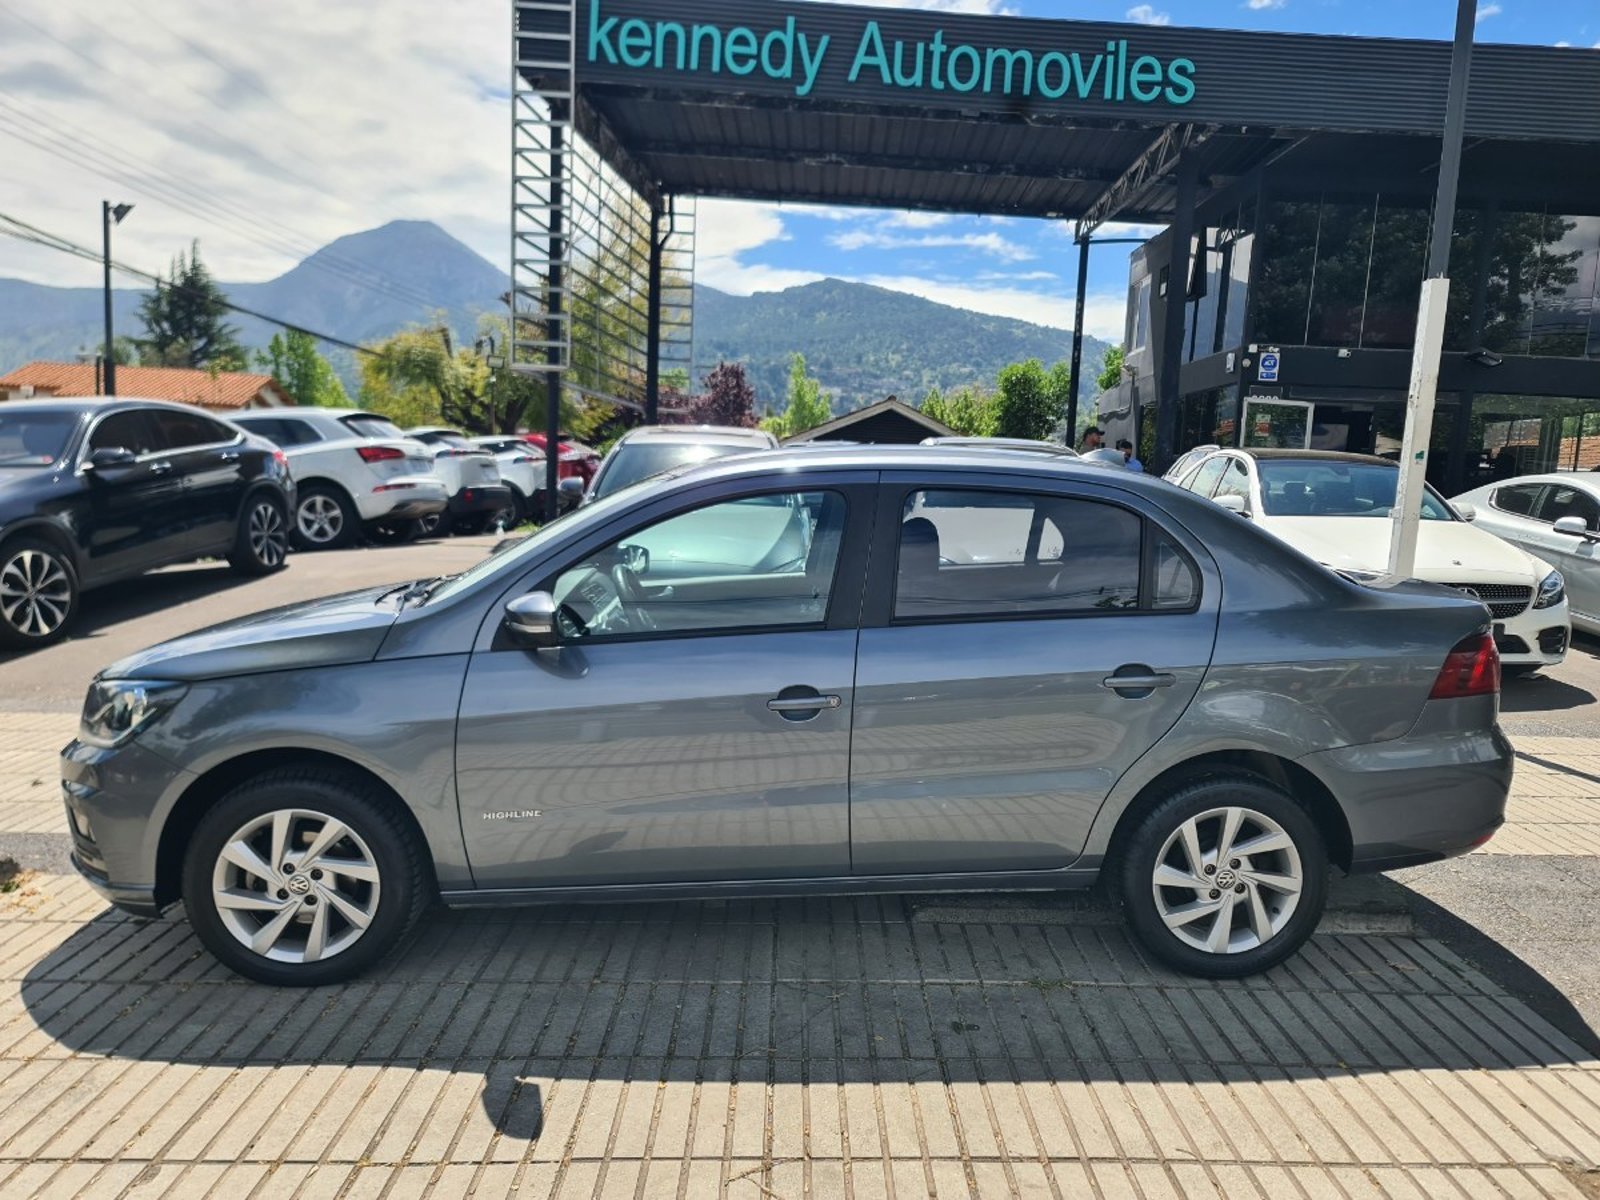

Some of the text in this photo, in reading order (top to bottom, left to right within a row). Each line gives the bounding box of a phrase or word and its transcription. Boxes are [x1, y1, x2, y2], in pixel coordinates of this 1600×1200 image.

[588, 0, 1196, 104] kennedy Automoviles
[483, 810, 543, 820] HIGHLINE
